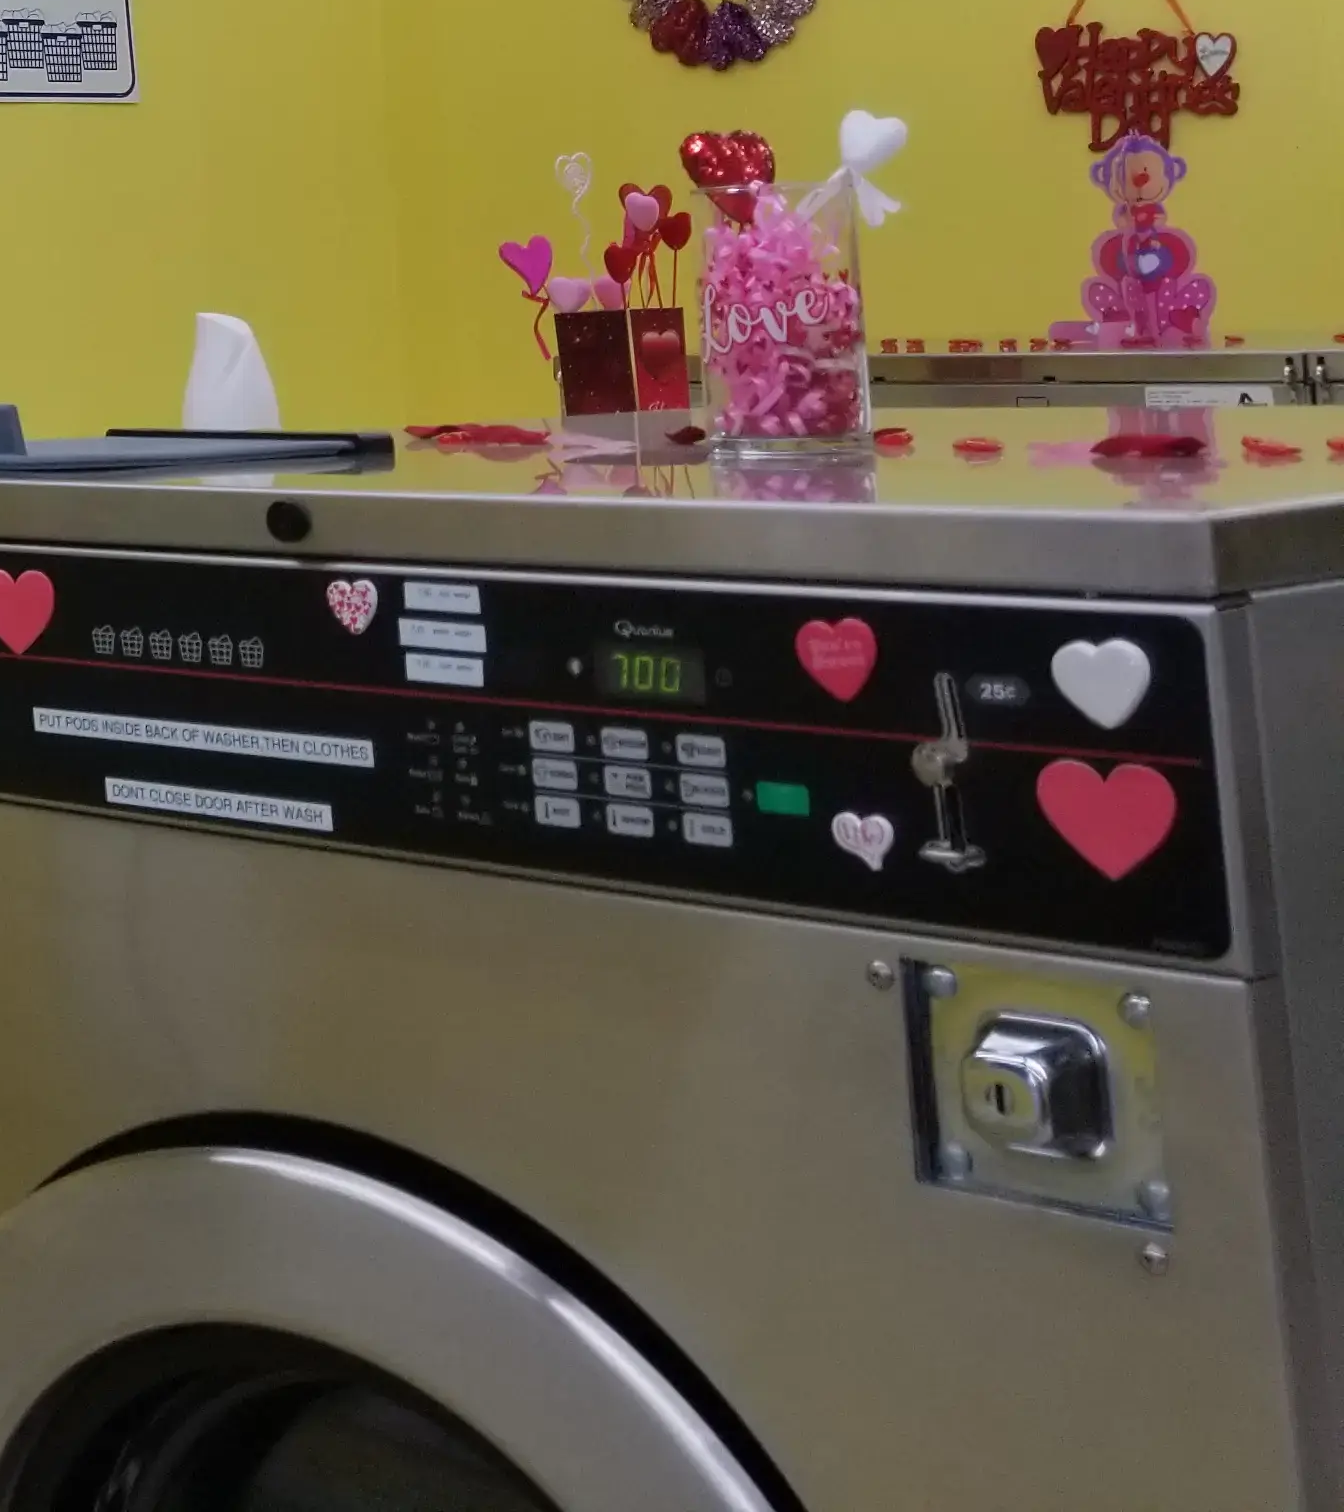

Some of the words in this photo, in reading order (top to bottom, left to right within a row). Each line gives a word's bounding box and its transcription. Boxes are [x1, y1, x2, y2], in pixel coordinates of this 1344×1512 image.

[612, 653, 682, 693] 700
[39, 713, 62, 728] PUT
[65, 716, 99, 732] PODS
[102, 720, 142, 737] INSIDE
[145, 724, 179, 740] BACK
[182, 728, 200, 742] OF
[302, 741, 369, 761] CLOTHES
[112, 784, 146, 800] DONT
[149, 788, 192, 807] CLOSE
[195, 794, 233, 811] DOOR
[236, 799, 279, 817] AFTER
[282, 805, 324, 824] WASH
